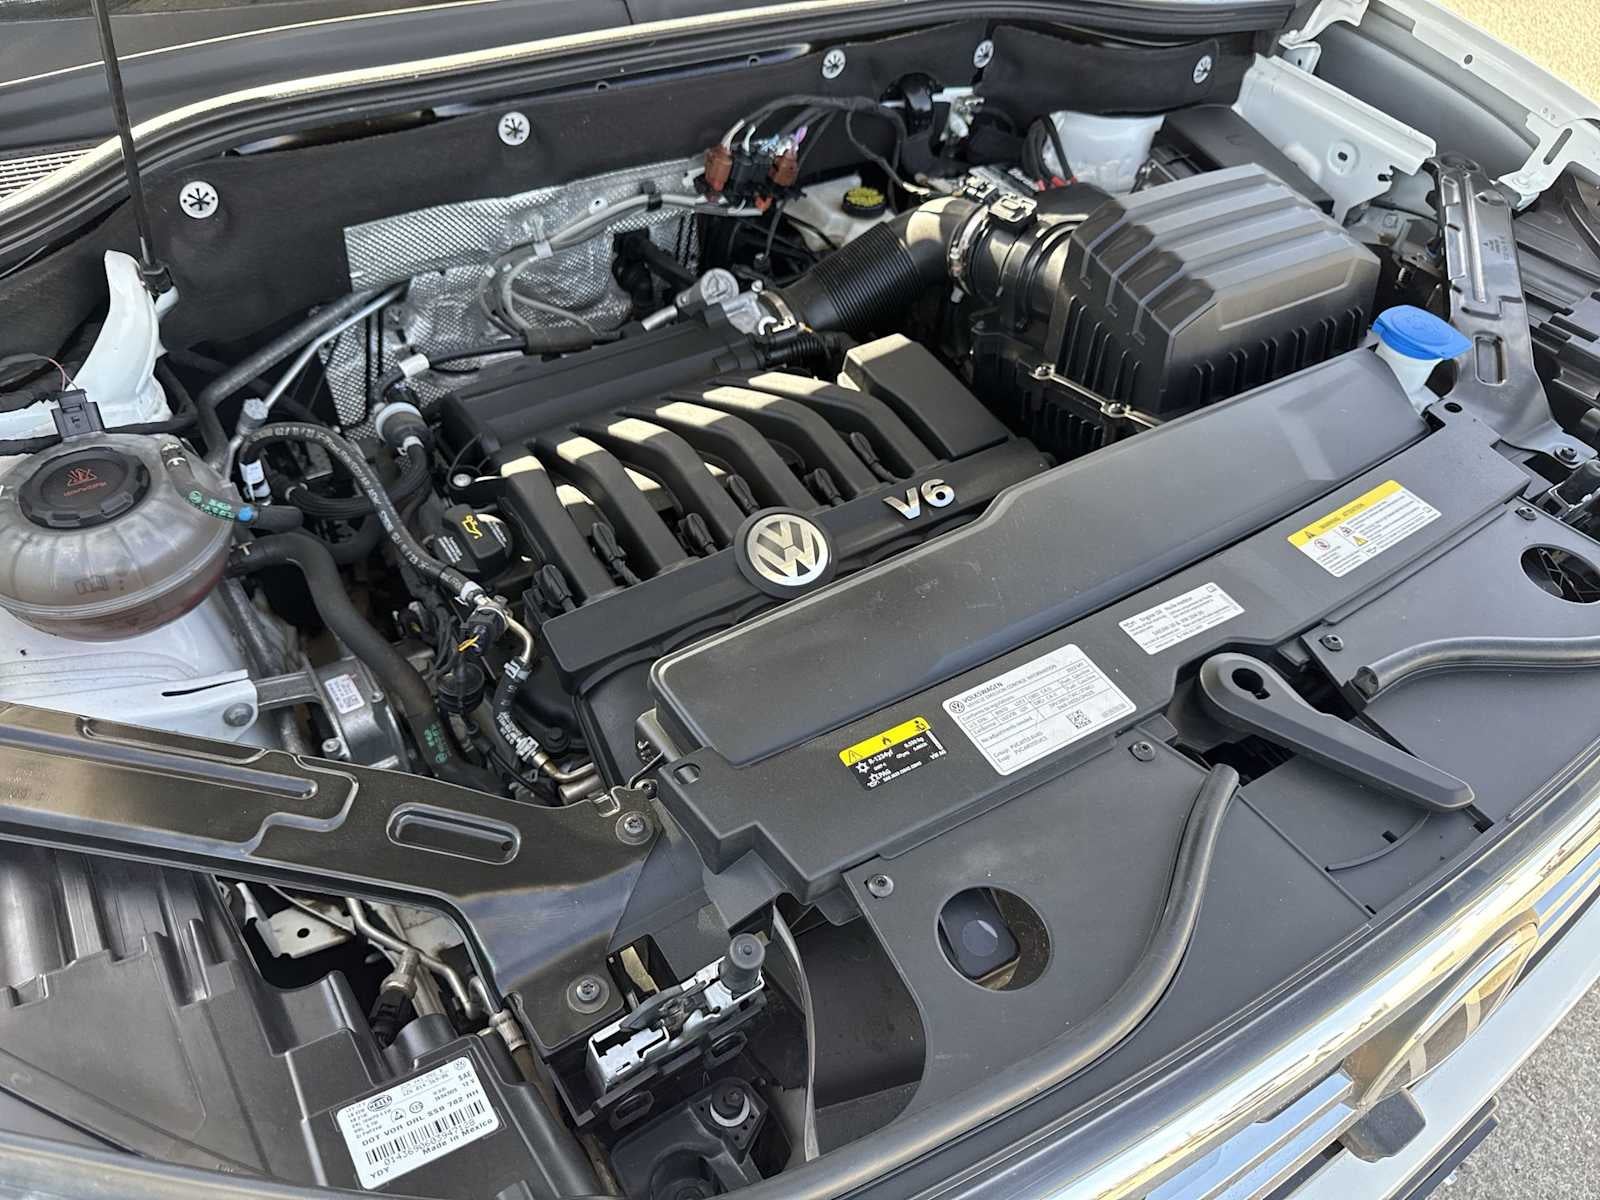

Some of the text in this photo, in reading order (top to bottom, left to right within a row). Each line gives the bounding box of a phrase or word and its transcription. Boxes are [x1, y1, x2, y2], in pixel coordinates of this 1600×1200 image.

[883, 479, 956, 520] V6
[961, 681, 1003, 703] VOLKSWAGEN
[362, 1134, 380, 1146] DOT
[422, 1140, 446, 1155] Made
[461, 1117, 493, 1136] Mexico
